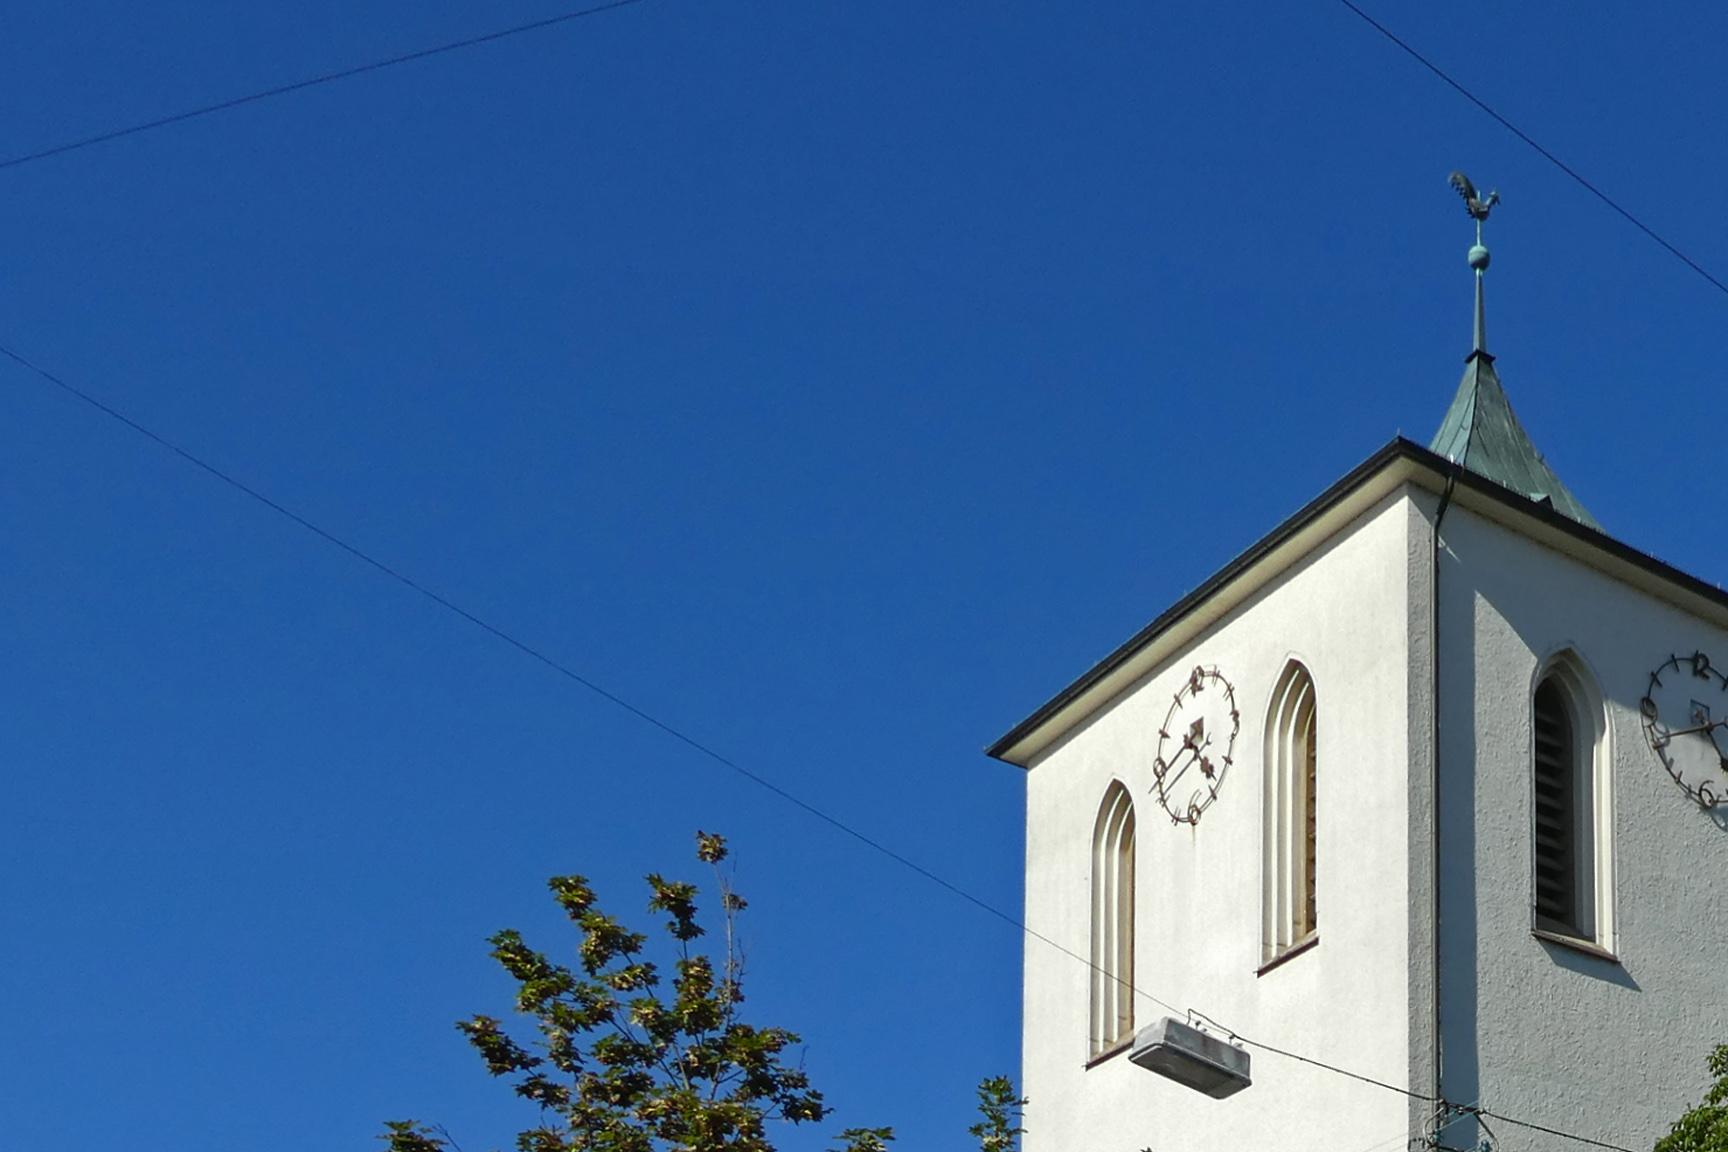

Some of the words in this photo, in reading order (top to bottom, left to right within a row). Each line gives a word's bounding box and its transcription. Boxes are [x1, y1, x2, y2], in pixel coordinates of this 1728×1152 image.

[1692, 650, 1710, 680] 12
[1188, 789, 1203, 826] 6
[1698, 779, 1714, 808] 6
